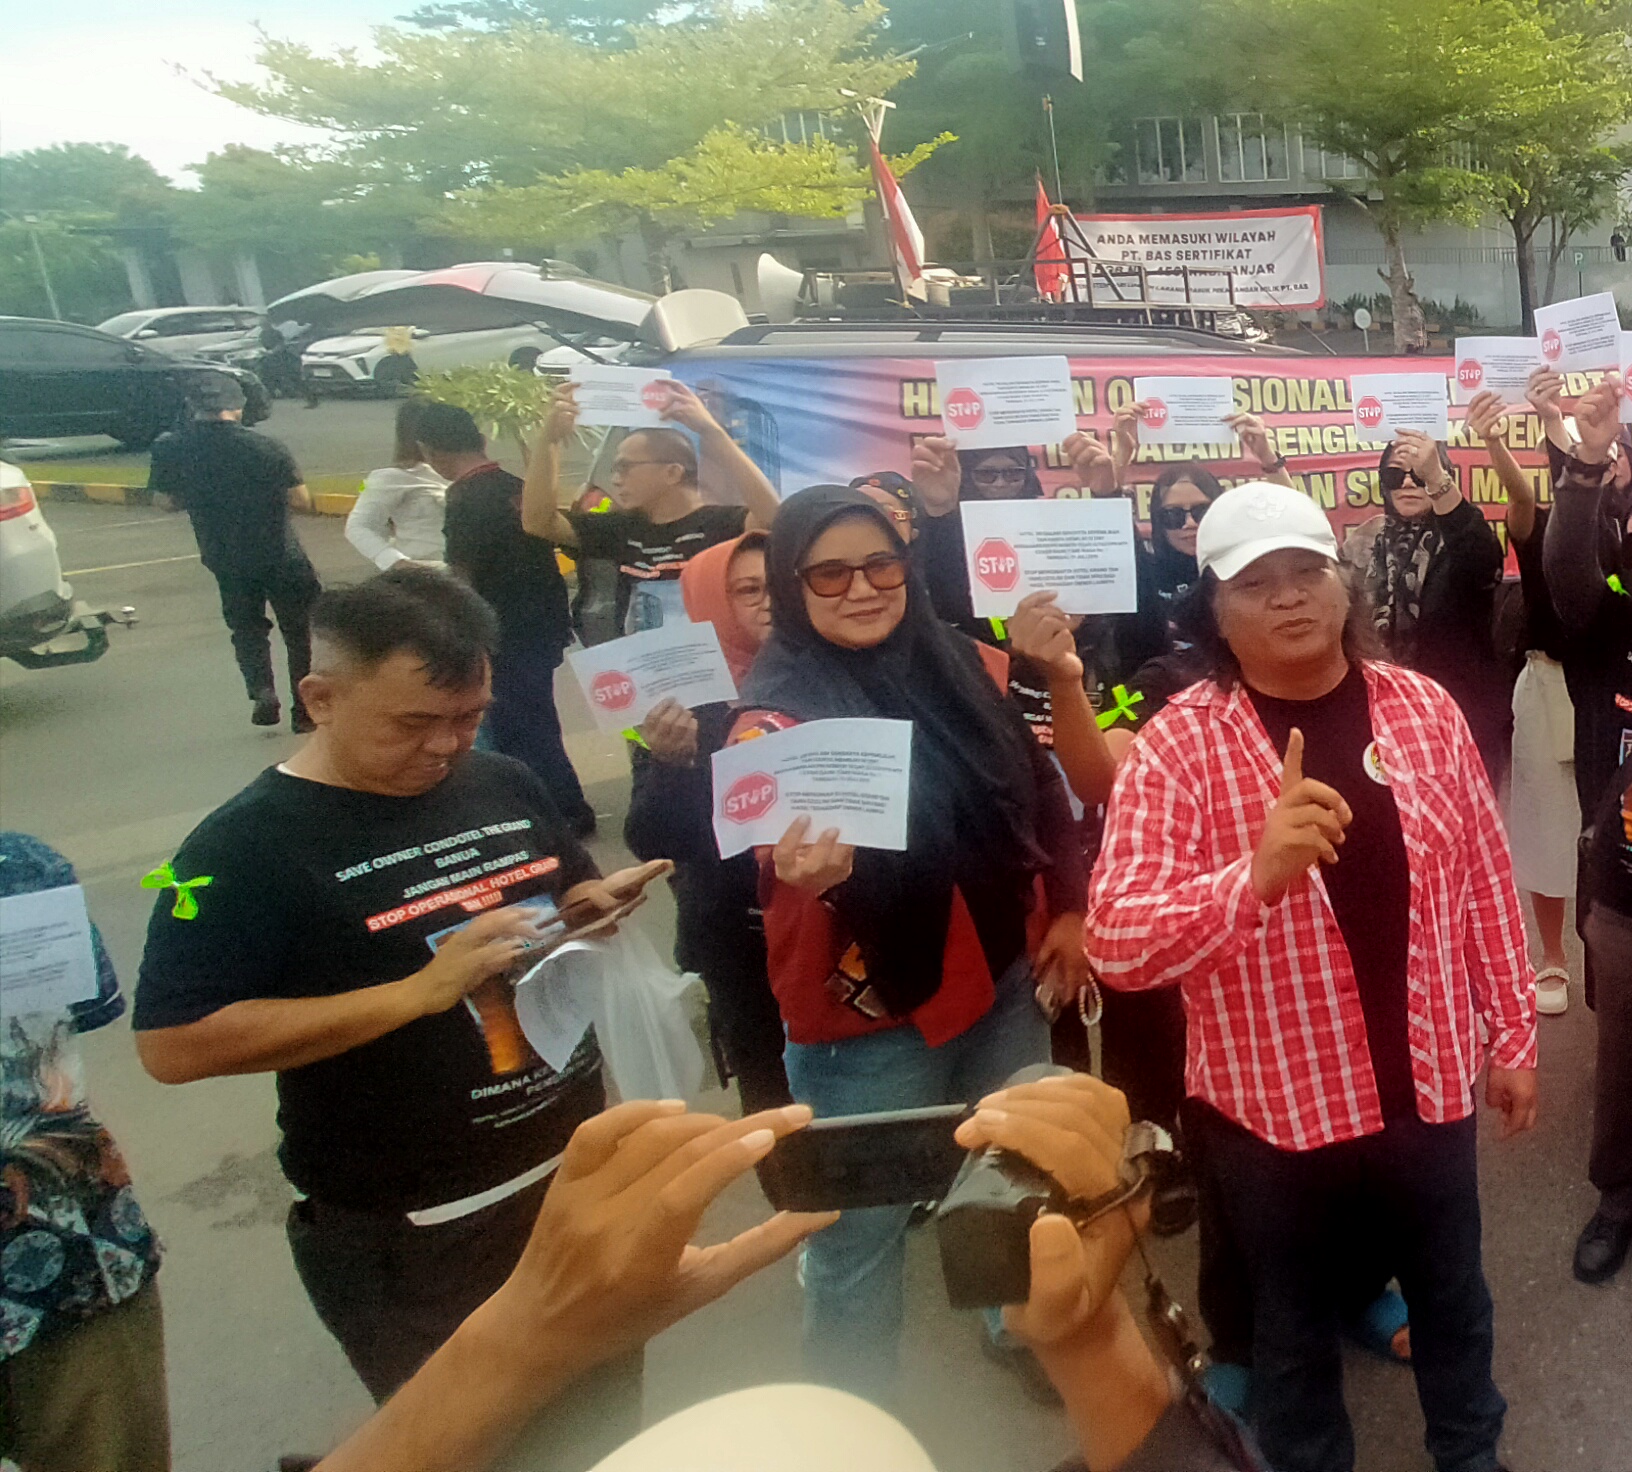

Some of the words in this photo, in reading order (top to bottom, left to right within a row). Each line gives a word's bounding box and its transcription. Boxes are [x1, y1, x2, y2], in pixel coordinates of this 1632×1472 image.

[1096, 234, 1135, 245] ANDA
[1139, 233, 1212, 245] MEMASUKI
[1214, 231, 1277, 243] WILAYAH
[1121, 250, 1142, 261] PT.
[1146, 249, 1173, 261] BAS
[1176, 248, 1253, 261] SERTIFIKAT
[335, 864, 373, 883] SAVE
[372, 847, 423, 870] OWNER
[423, 830, 483, 855] CONDOTEL
[434, 848, 481, 869] BANUA
[403, 875, 450, 899] JANGAN
[450, 865, 484, 885] MAIN
[483, 850, 530, 873] RAMPAS
[369, 909, 410, 931] STOP
[408, 883, 486, 916] OPERASIONAL
[490, 868, 530, 889] HOTEL
